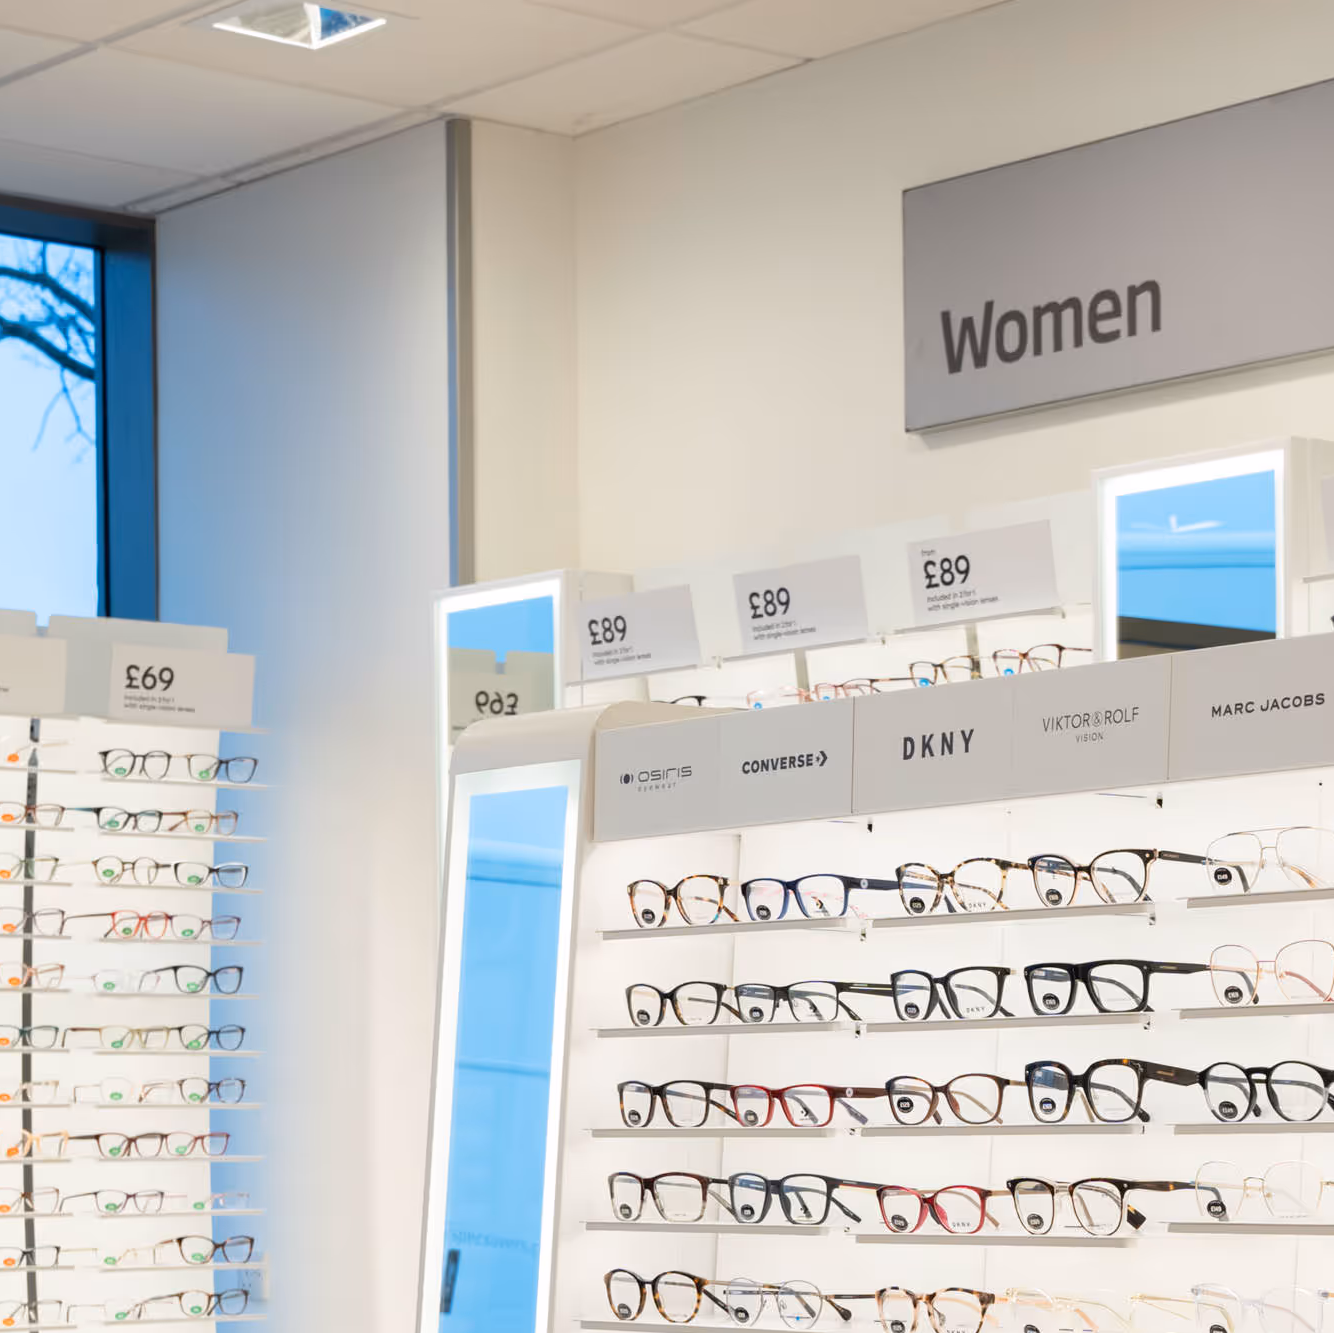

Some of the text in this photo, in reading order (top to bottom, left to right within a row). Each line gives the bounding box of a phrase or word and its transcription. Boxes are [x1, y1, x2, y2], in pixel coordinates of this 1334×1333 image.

[941, 279, 1162, 374] Women
[923, 555, 970, 589] £89
[748, 587, 790, 619] £89
[588, 615, 627, 645] £89
[125, 664, 174, 691] £69
[1211, 693, 1325, 718] MARC JACOBS
[902, 729, 974, 760] DKNY
[1075, 732, 1104, 743] VISION
[741, 753, 814, 775] CONVERSE
